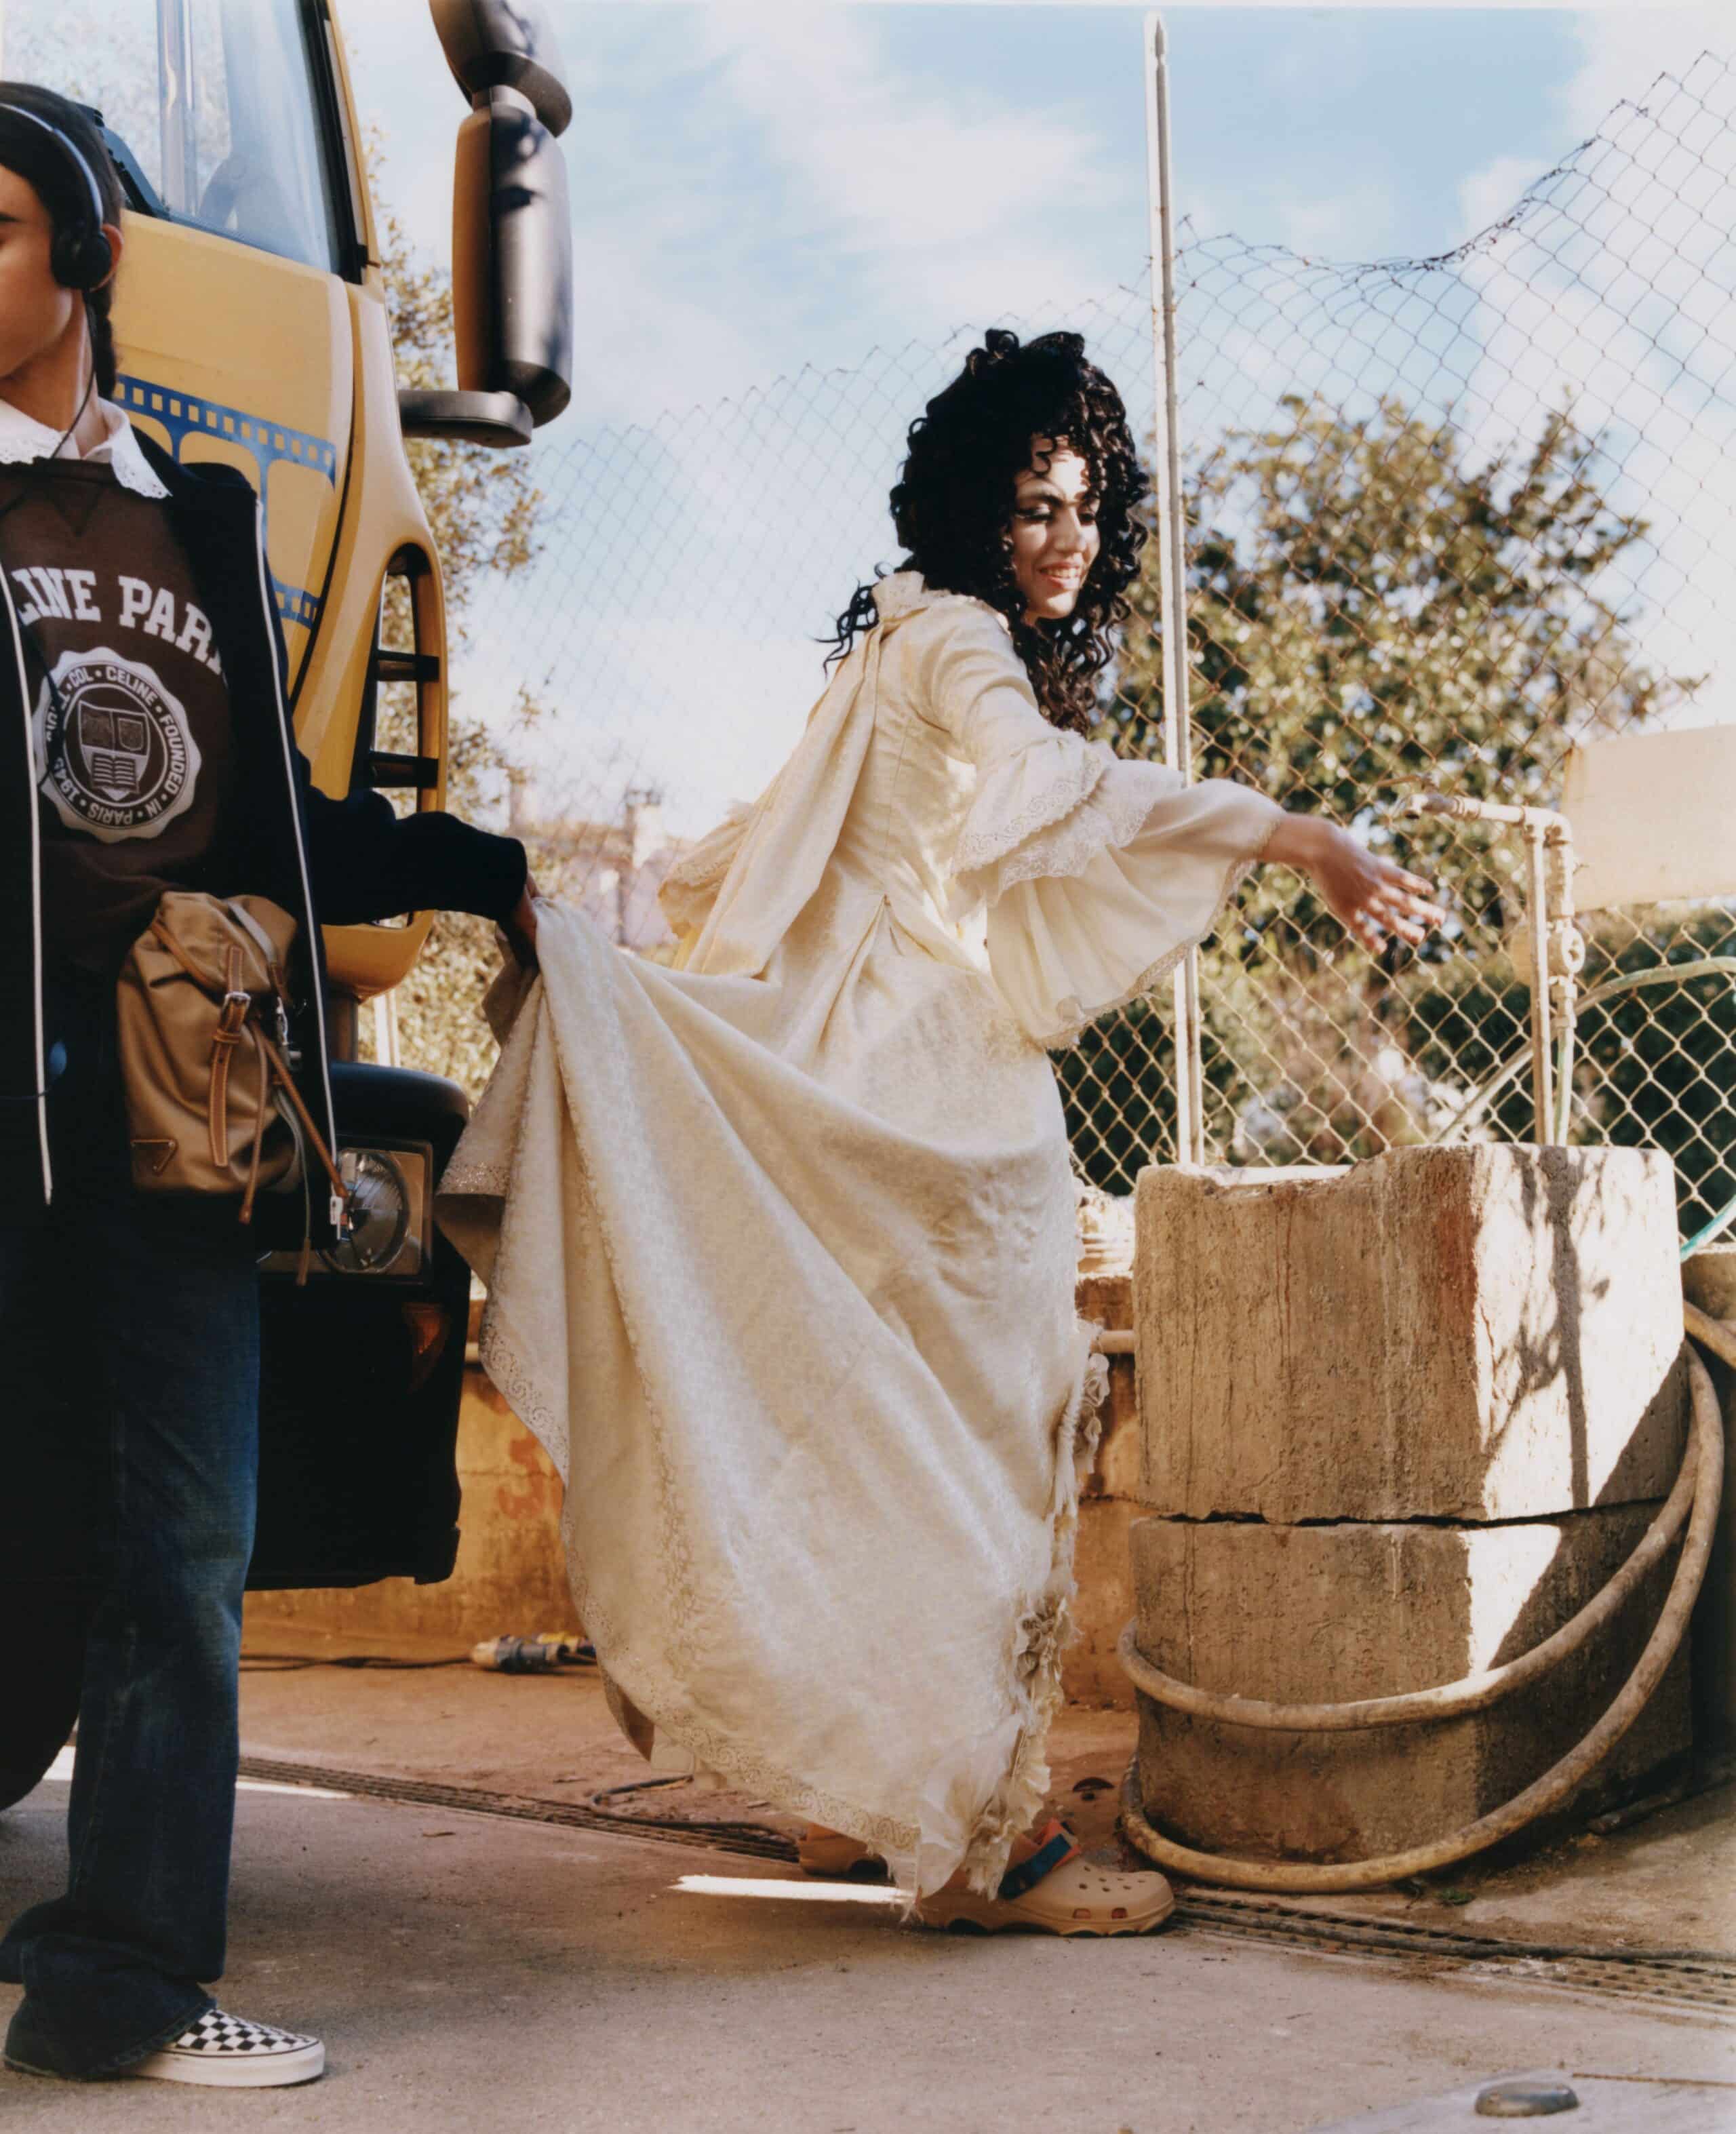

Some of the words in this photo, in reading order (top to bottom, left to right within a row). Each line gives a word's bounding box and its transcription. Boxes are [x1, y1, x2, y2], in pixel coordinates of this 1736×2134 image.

[105, 665, 157, 707] CELINE
[158, 714, 184, 795] FOUNDED
[87, 802, 133, 825] PARIS
[145, 799, 163, 818] IN
